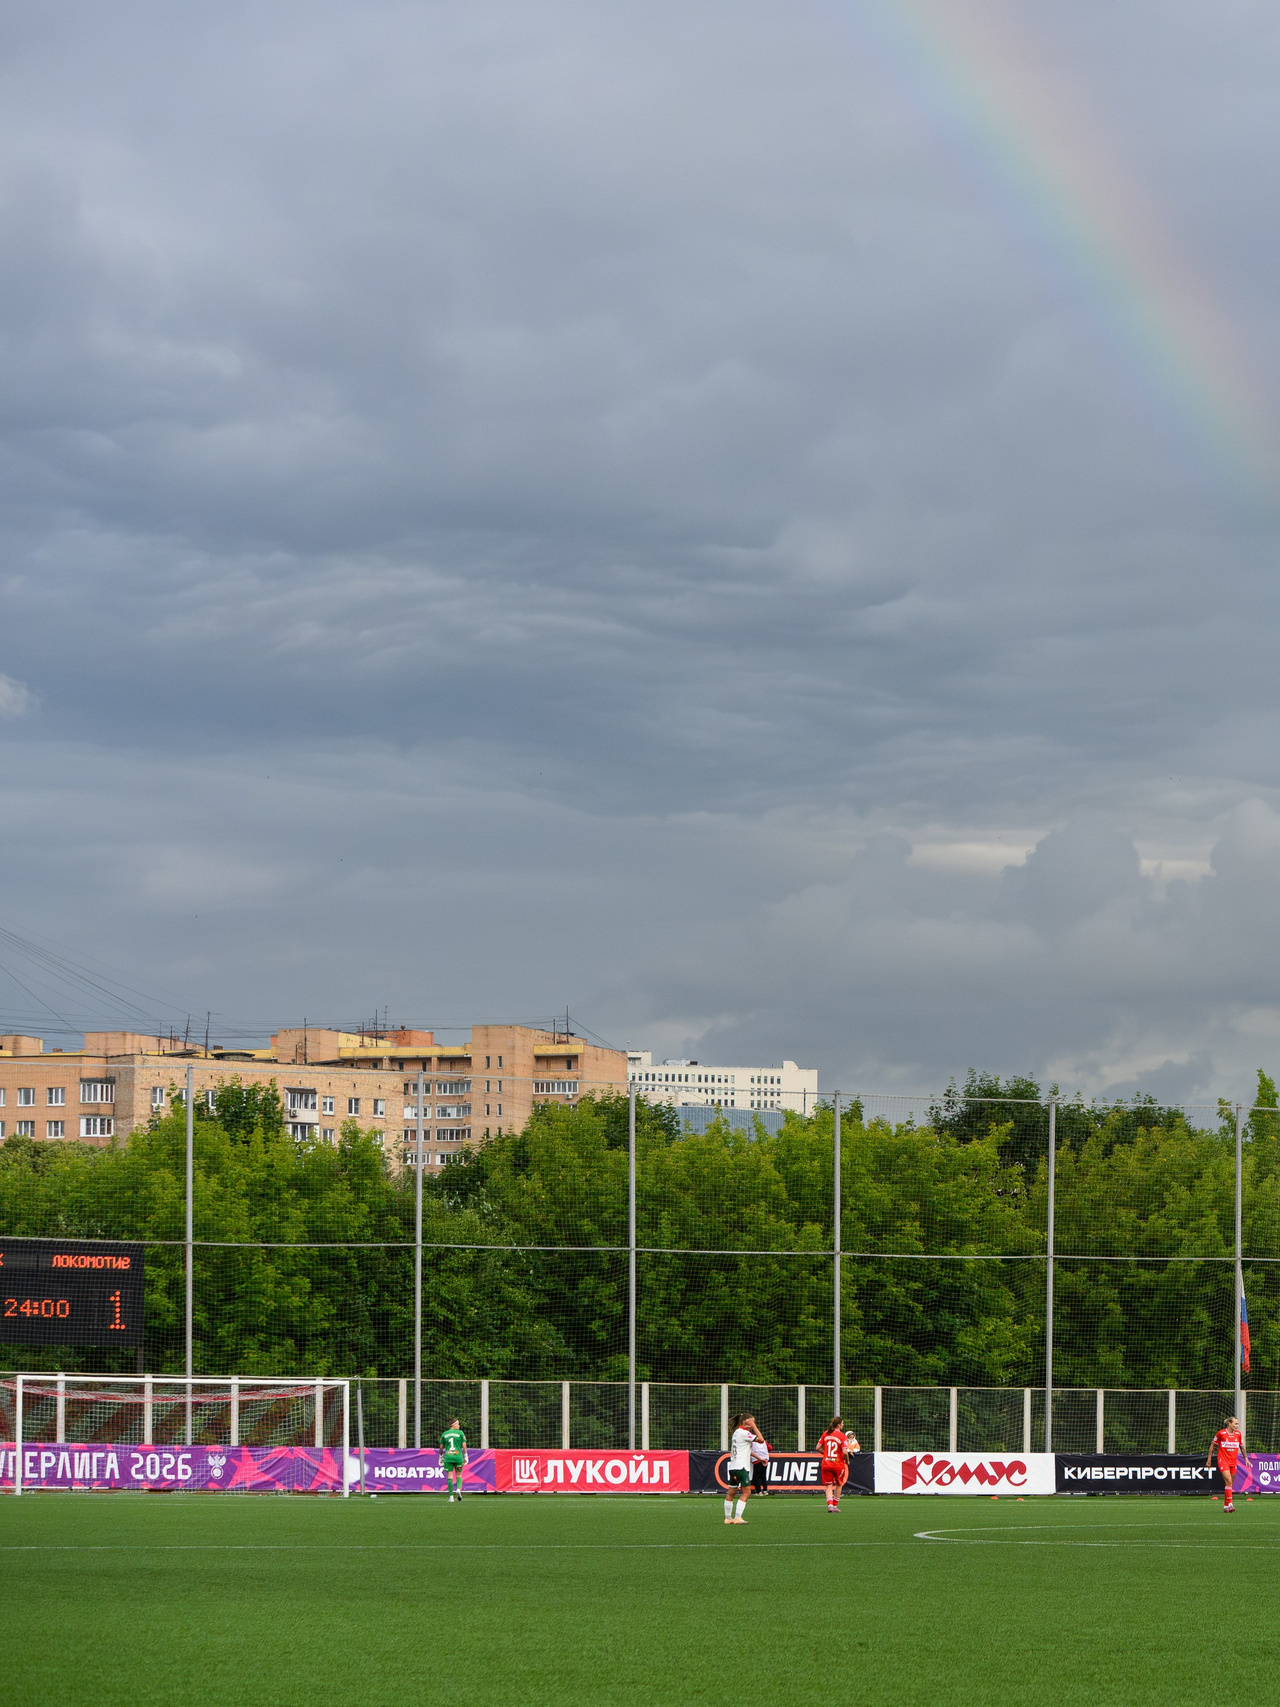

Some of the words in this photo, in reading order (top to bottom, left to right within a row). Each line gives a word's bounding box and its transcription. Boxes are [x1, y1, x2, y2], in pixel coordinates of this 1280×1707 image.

[4, 1298, 70, 1318] 24:00
[109, 1290, 126, 1330] 1
[448, 1437, 456, 1451] 1
[826, 1440, 839, 1458] 12
[130, 1452, 192, 1480] 2026
[374, 1466, 445, 1479] НОВАТЭК
[543, 1454, 670, 1485] ЛУКОЙЛ
[1064, 1466, 1217, 1480] КИБЕРПРОТЕКТ
